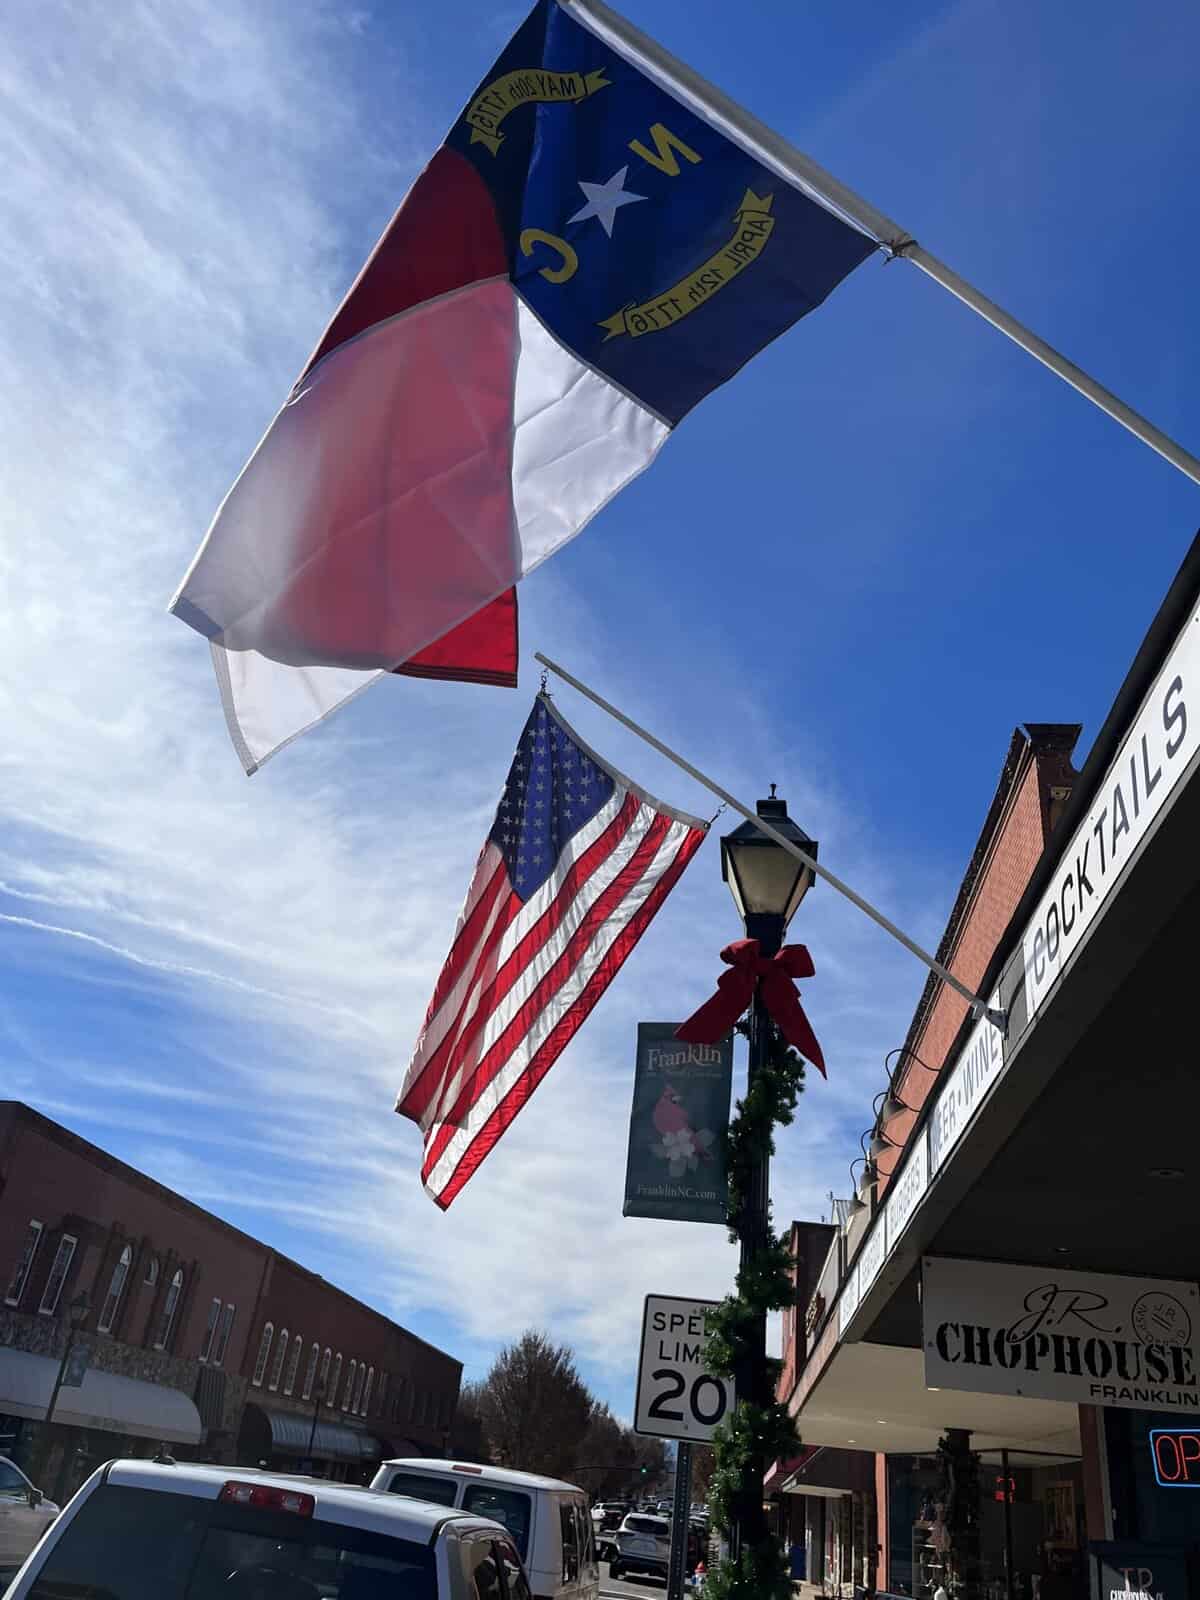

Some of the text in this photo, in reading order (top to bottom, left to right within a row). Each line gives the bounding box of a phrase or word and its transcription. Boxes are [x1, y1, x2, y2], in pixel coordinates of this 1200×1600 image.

[1032, 674, 1188, 985] COCKTAILS
[647, 1042, 722, 1071] Franklin
[962, 1024, 999, 1107] WINE
[652, 1311, 704, 1336] SPE
[1005, 1283, 1122, 1343] J.R.
[659, 1340, 701, 1364] LIM
[935, 1321, 1198, 1387] CHOPHOUSE
[648, 1368, 727, 1426] 20
[1089, 1383, 1199, 1406] FRANKLIN
